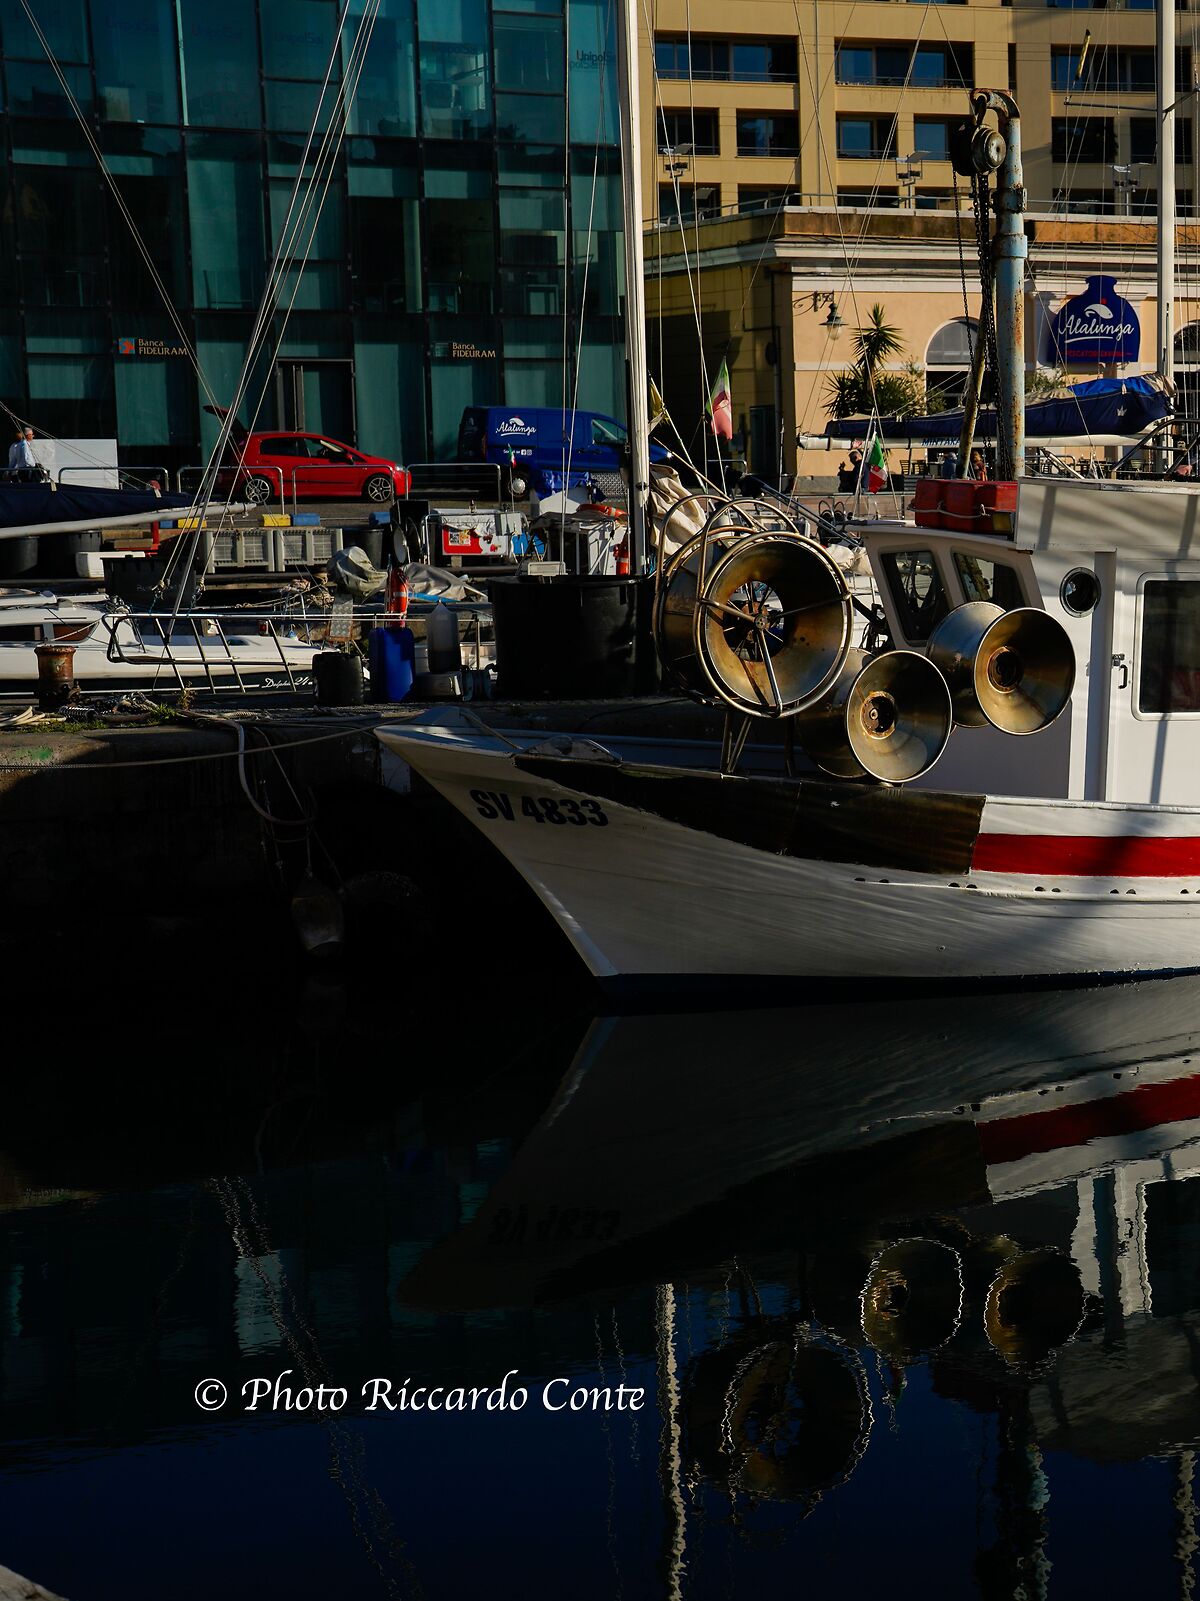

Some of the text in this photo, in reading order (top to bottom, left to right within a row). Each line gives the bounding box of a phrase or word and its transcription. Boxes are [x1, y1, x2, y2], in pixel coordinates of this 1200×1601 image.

[1058, 314, 1135, 342] Alalunga
[138, 338, 164, 347] Banca
[452, 342, 476, 350] Banca
[138, 346, 188, 356] FIDEURAM
[452, 350, 497, 358] FIDEURAM
[495, 421, 537, 436] Alalunga
[469, 789, 609, 827] SV 4833
